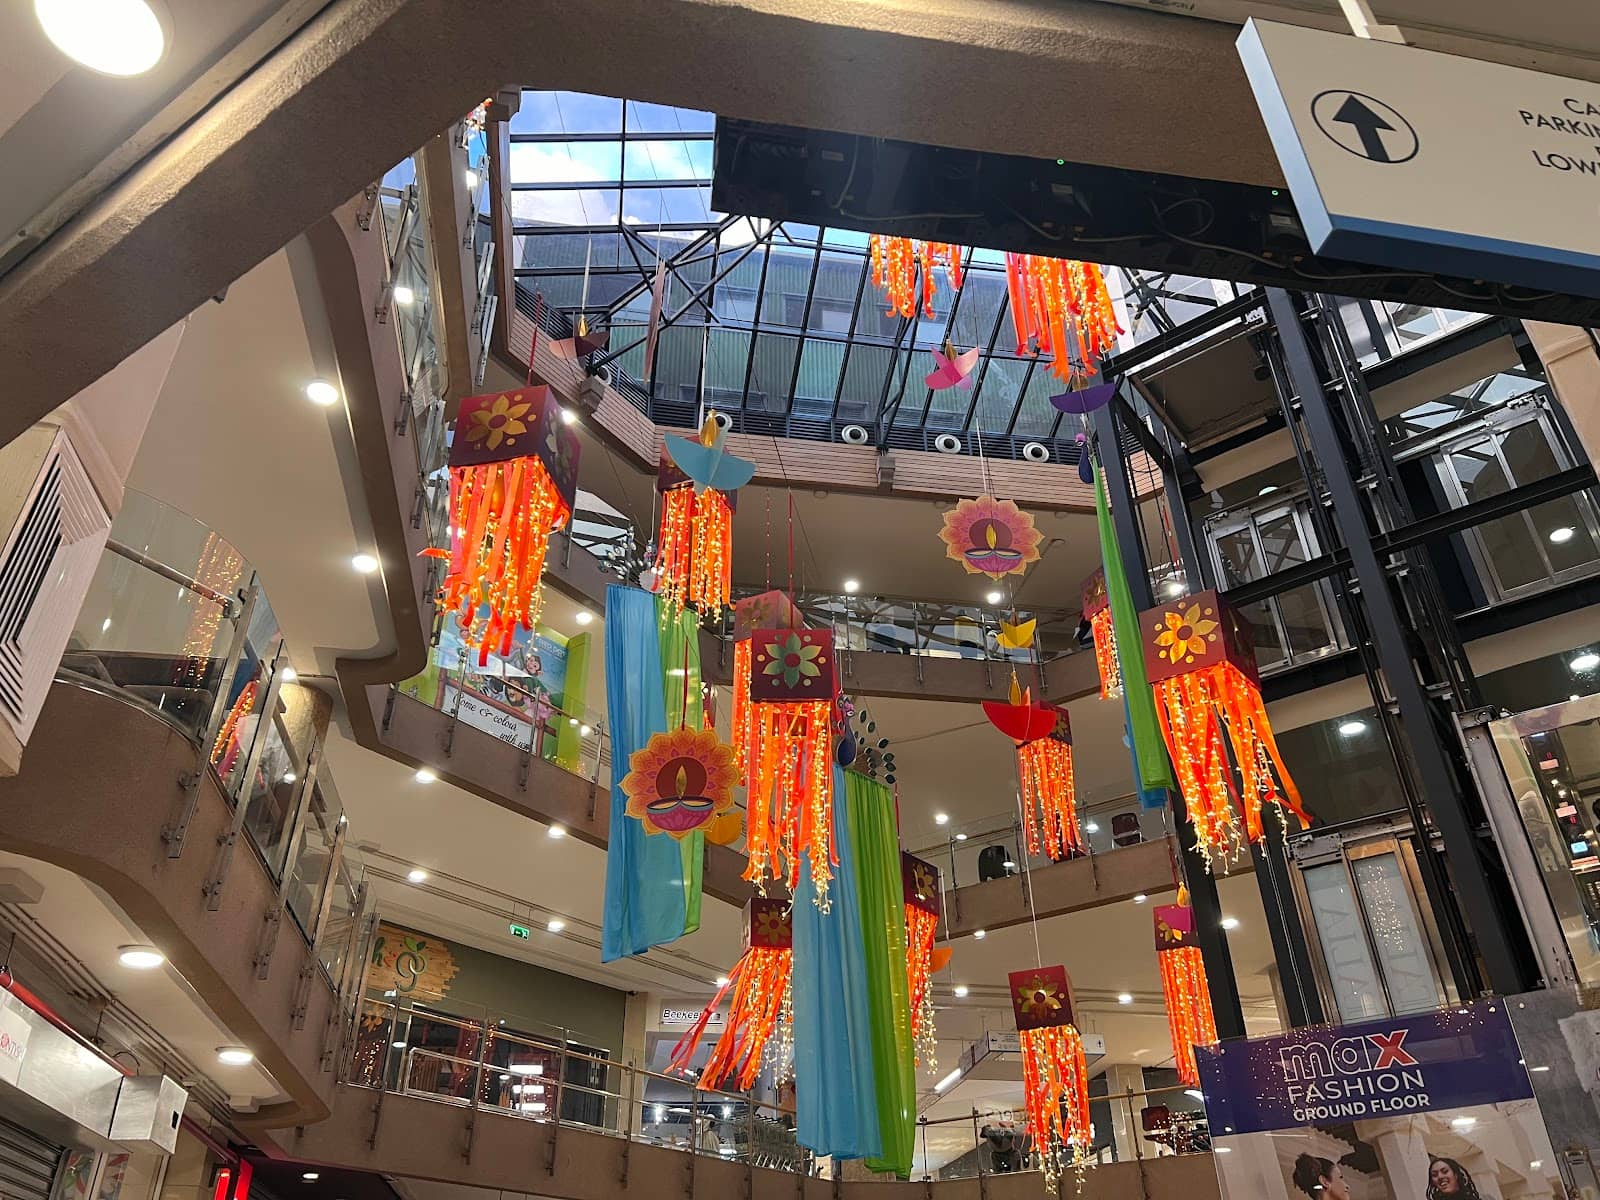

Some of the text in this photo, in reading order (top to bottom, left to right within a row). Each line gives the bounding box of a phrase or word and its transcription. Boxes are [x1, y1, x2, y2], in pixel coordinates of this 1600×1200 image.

[1563, 98, 1600, 116] CA
[1531, 150, 1600, 176] LOW
[1279, 1029, 1419, 1082] max
[1287, 1069, 1425, 1104] FASHION
[1293, 1094, 1431, 1122] GROUND FLOOR
